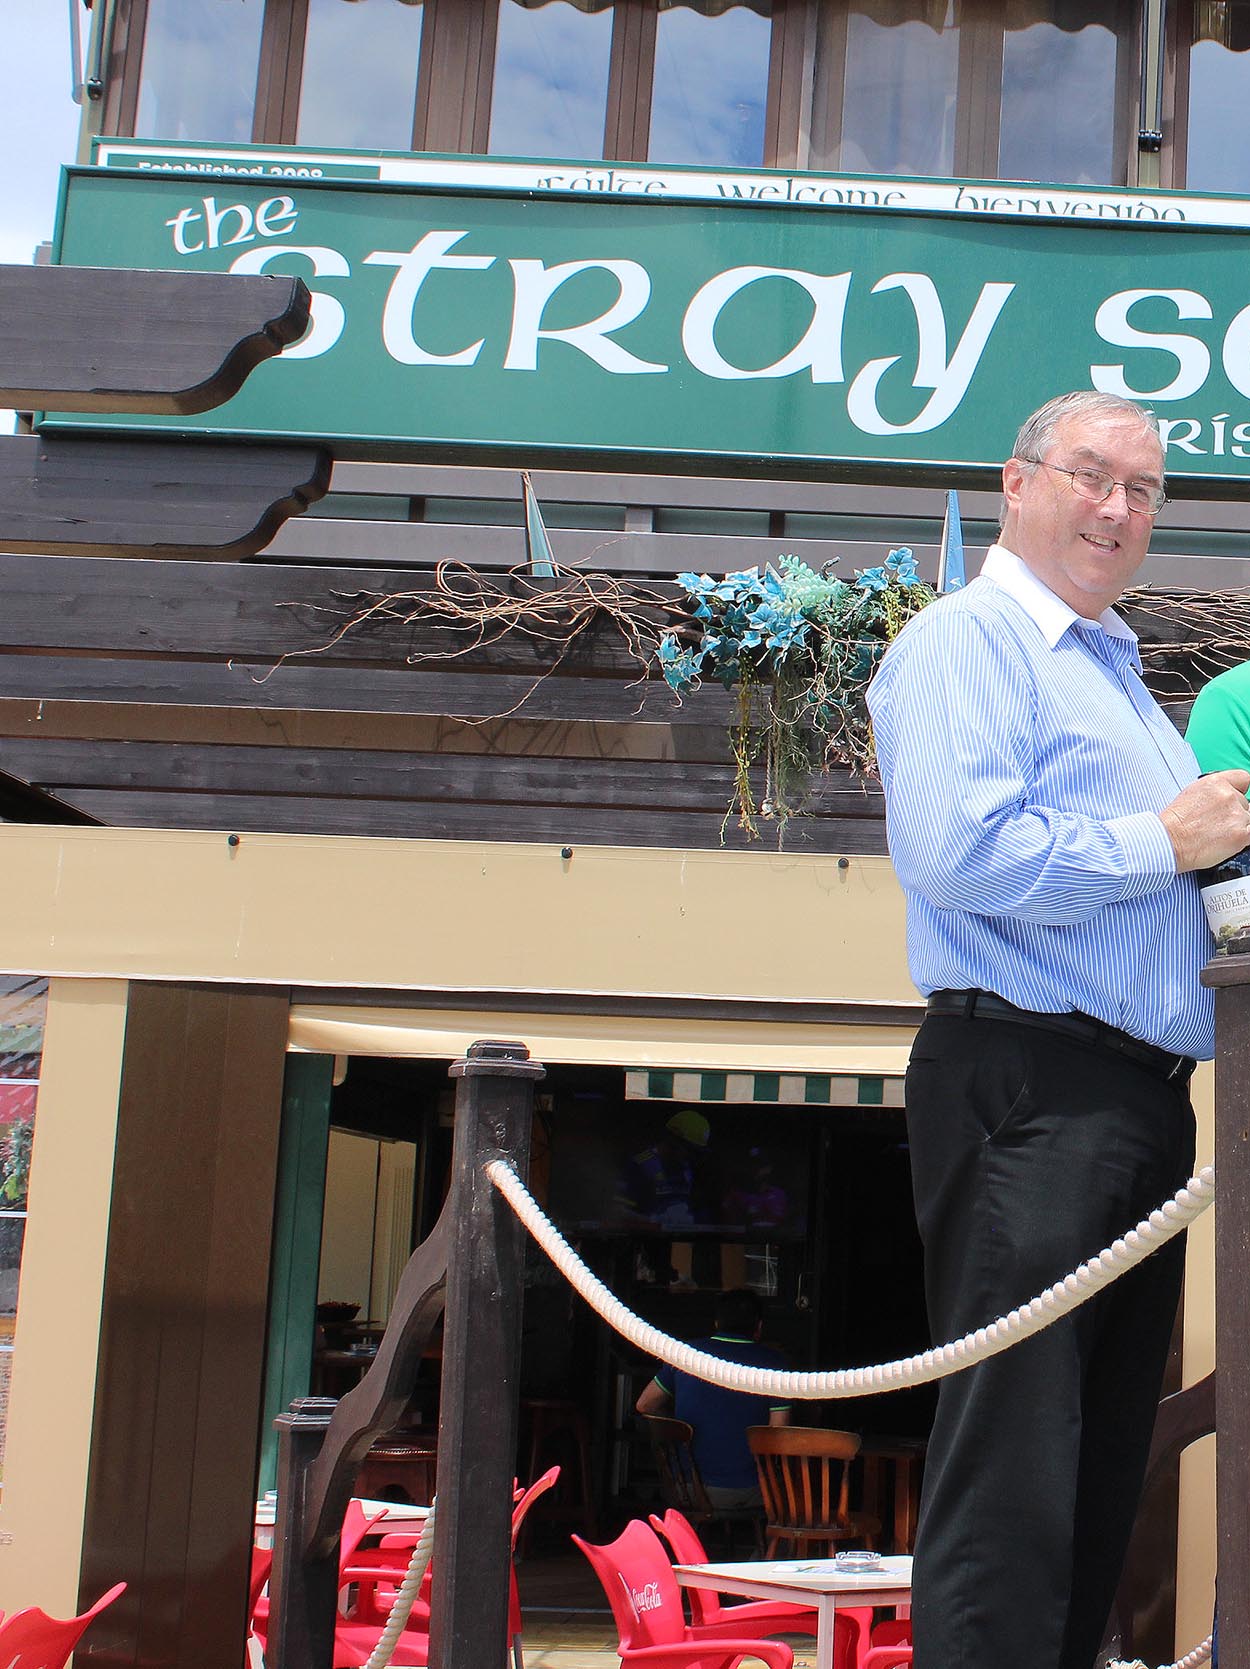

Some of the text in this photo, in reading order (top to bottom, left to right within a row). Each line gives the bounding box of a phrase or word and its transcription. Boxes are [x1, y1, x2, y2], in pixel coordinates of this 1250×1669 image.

[165, 195, 298, 255] the
[1209, 888, 1247, 904] ALTOS DE
[1206, 897, 1249, 914] ORIHUELA
